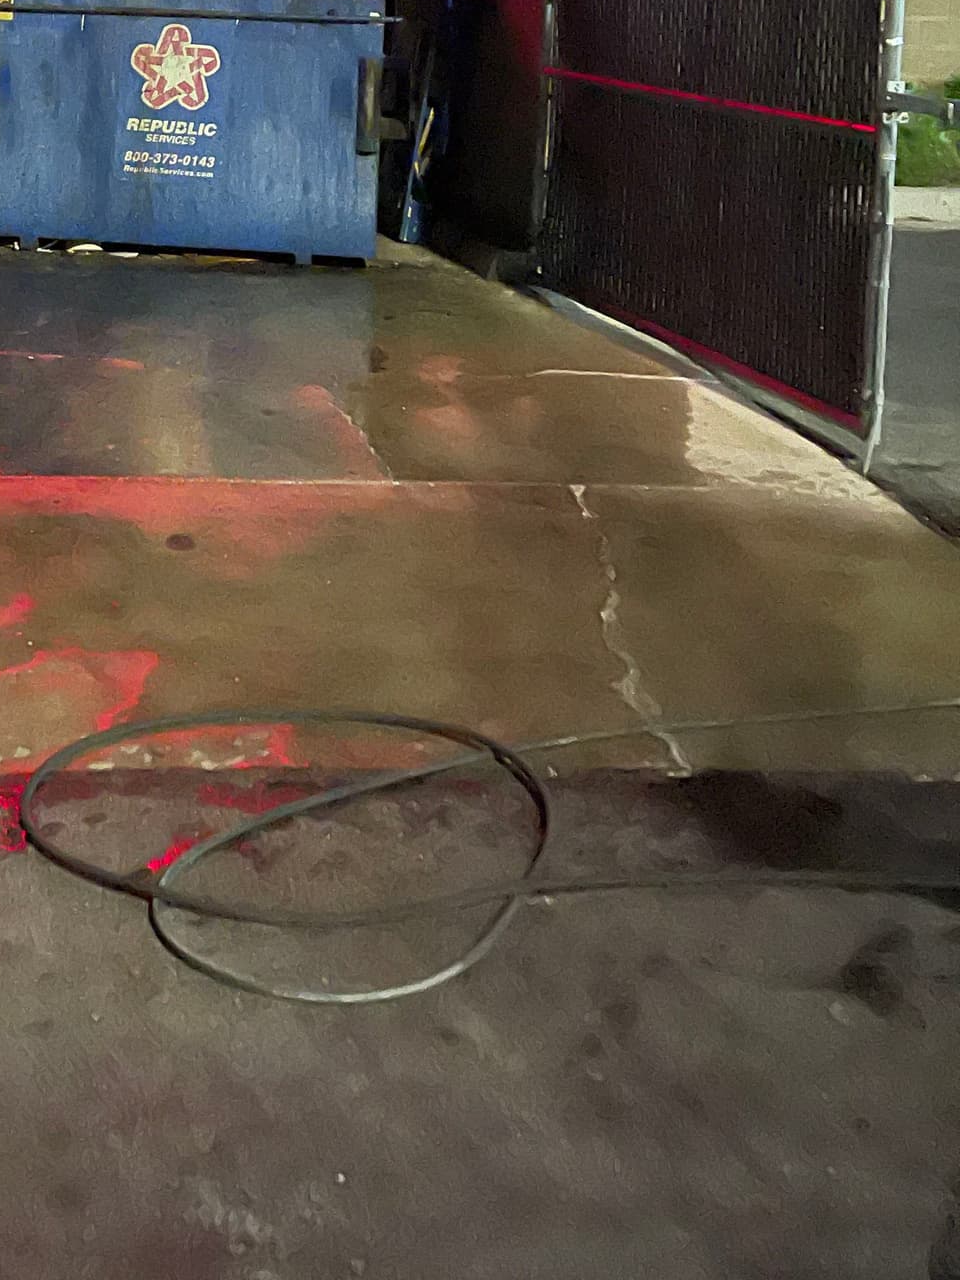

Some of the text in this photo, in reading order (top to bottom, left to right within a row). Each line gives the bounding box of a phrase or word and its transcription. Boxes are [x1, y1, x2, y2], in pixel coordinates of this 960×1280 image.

[126, 117, 218, 137] REPUBLIC
[145, 133, 196, 146] SERVICES
[124, 150, 216, 168] 800-373-0143
